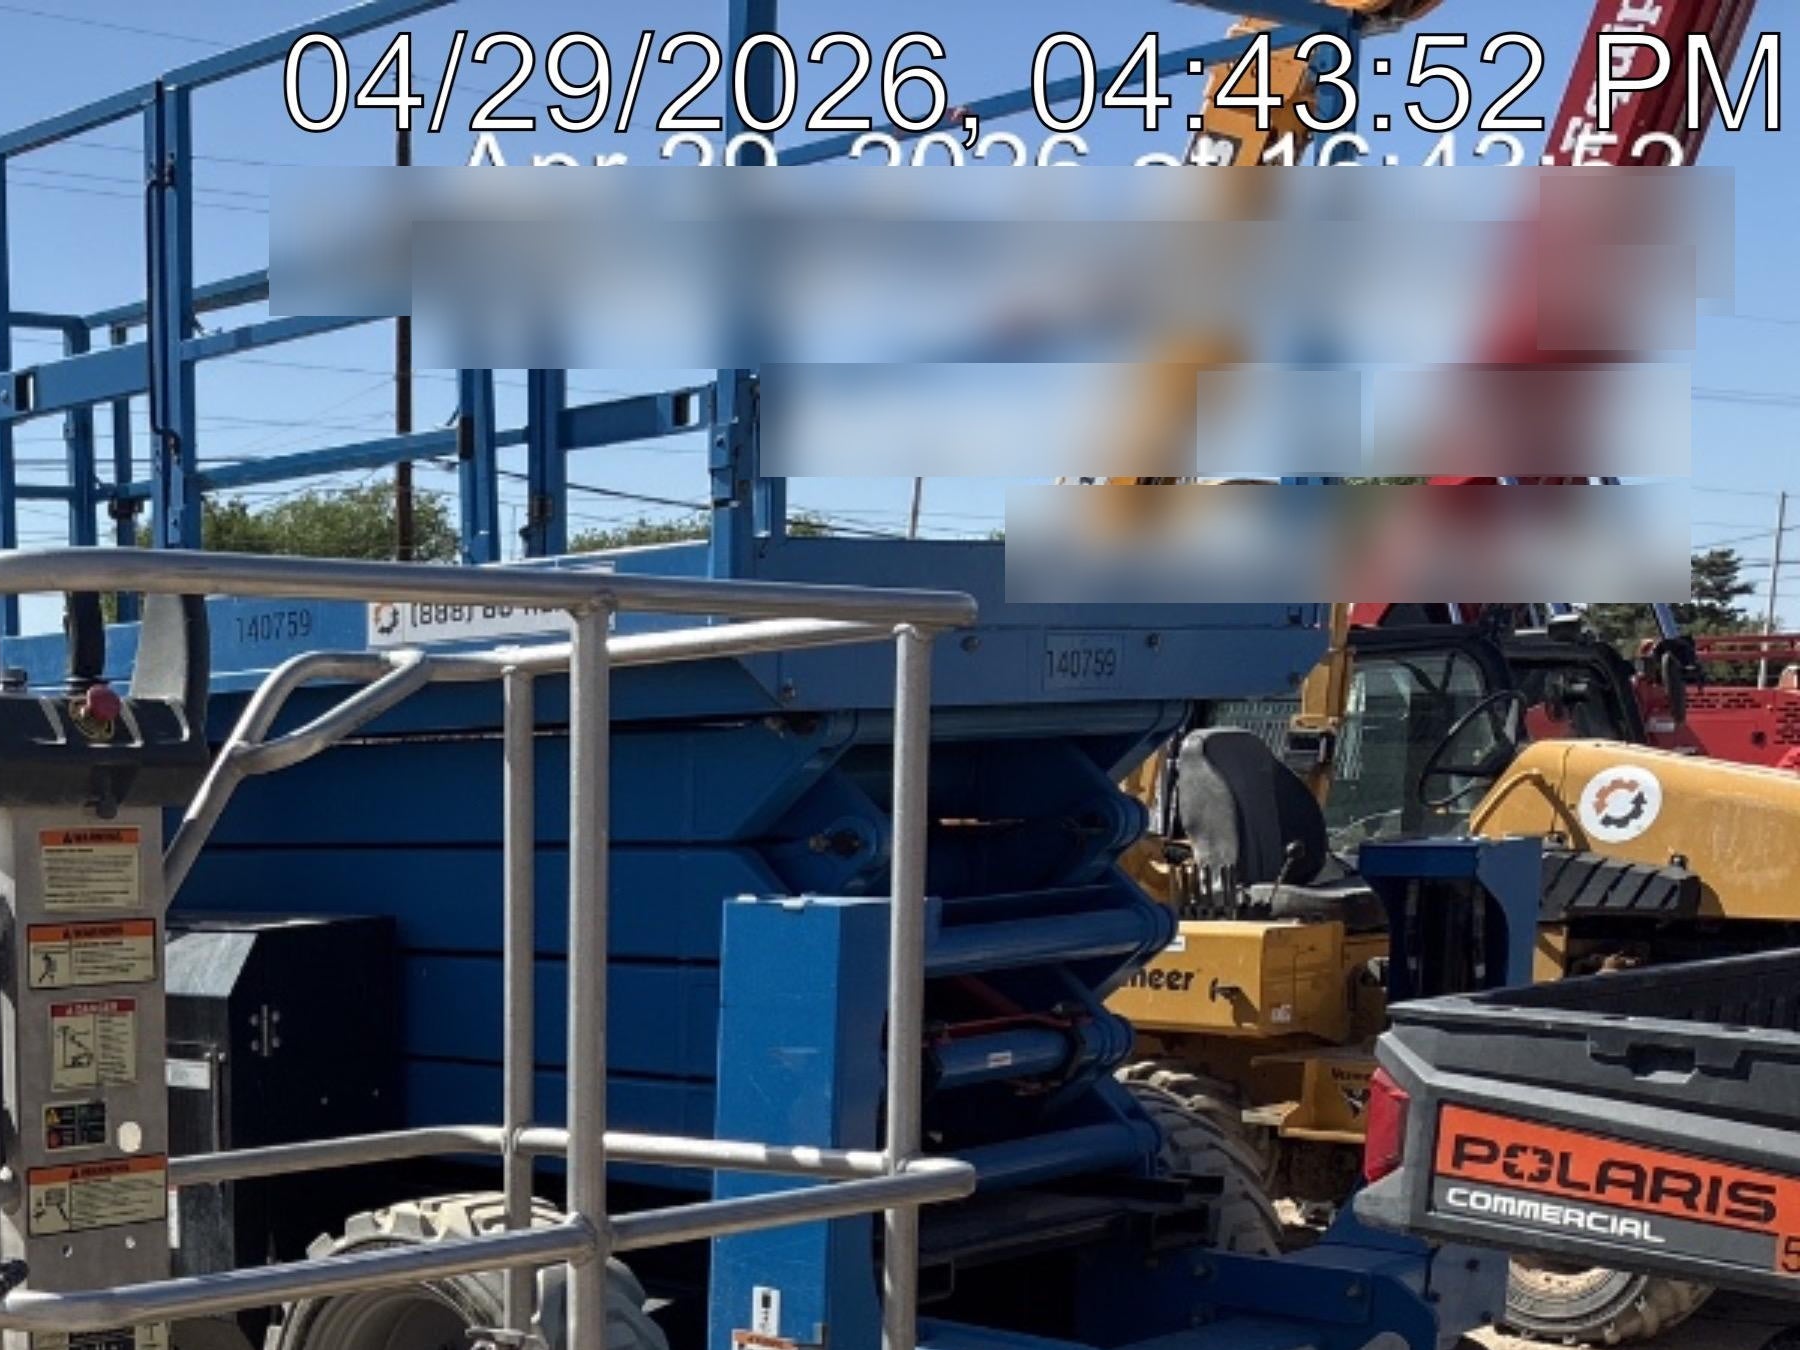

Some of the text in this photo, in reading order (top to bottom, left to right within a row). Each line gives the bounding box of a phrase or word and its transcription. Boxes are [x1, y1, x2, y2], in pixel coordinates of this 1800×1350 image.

[236, 609, 313, 643] 140759
[1046, 647, 1117, 679] 140759
[1451, 1133, 1777, 1224] POLARIS
[1447, 1187, 1666, 1243] COMMERCIAL
